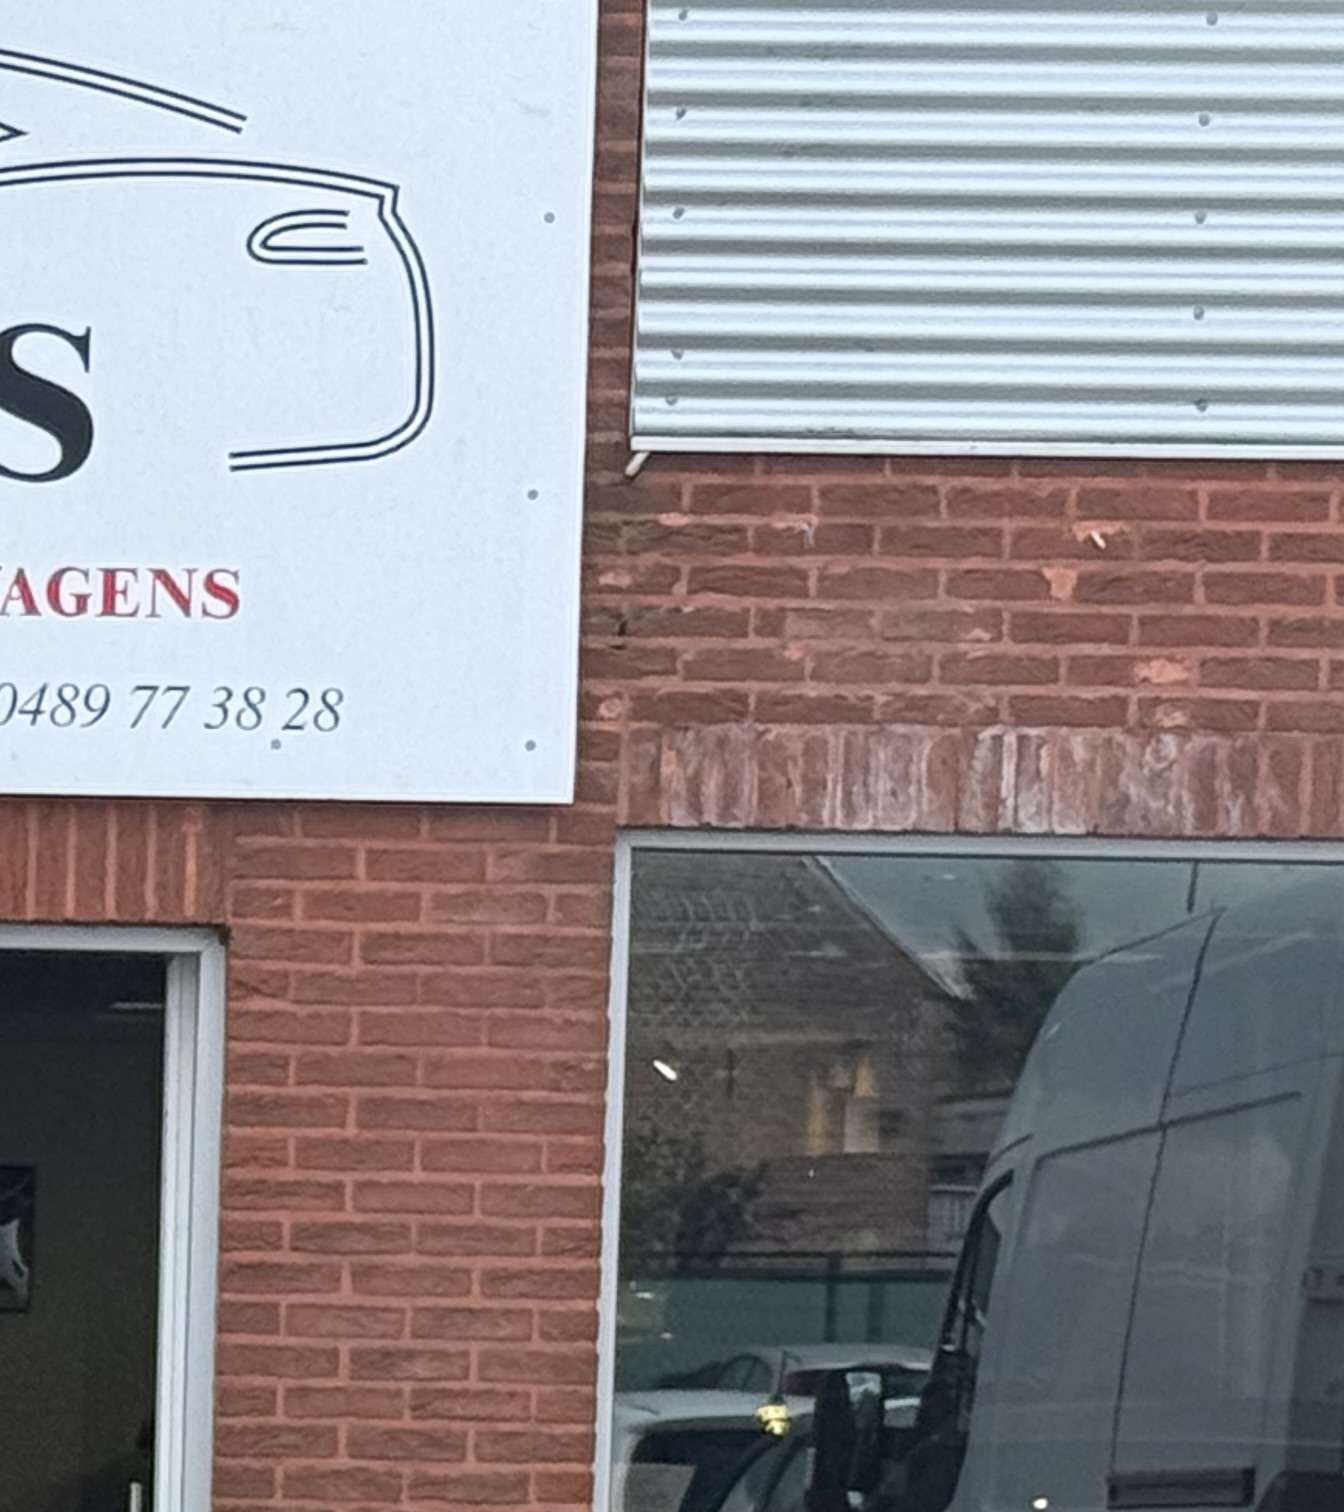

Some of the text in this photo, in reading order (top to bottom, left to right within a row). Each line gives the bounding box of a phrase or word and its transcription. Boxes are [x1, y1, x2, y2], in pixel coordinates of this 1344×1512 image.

[131, 685, 190, 729] 77
[204, 686, 265, 730] 38
[282, 688, 343, 731] 28
